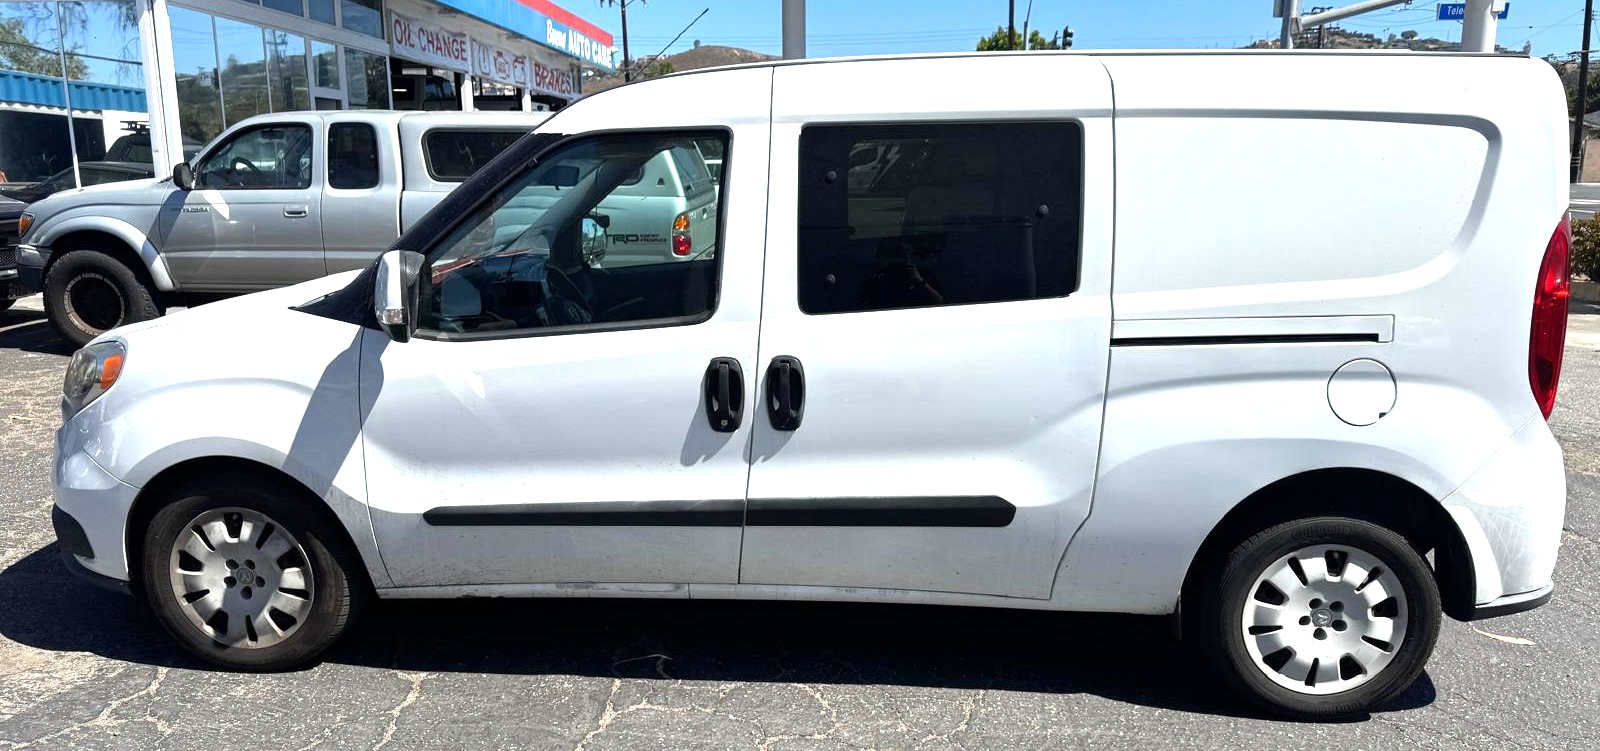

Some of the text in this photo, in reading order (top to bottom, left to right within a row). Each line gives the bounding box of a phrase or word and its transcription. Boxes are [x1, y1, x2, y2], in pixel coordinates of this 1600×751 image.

[1447, 6, 1464, 15] Tele
[394, 19, 468, 61] OIL CHANGE
[569, 28, 591, 60] AUTO
[592, 41, 613, 69] CARE
[534, 63, 572, 94] BRAKES
[607, 234, 639, 244] TRD
